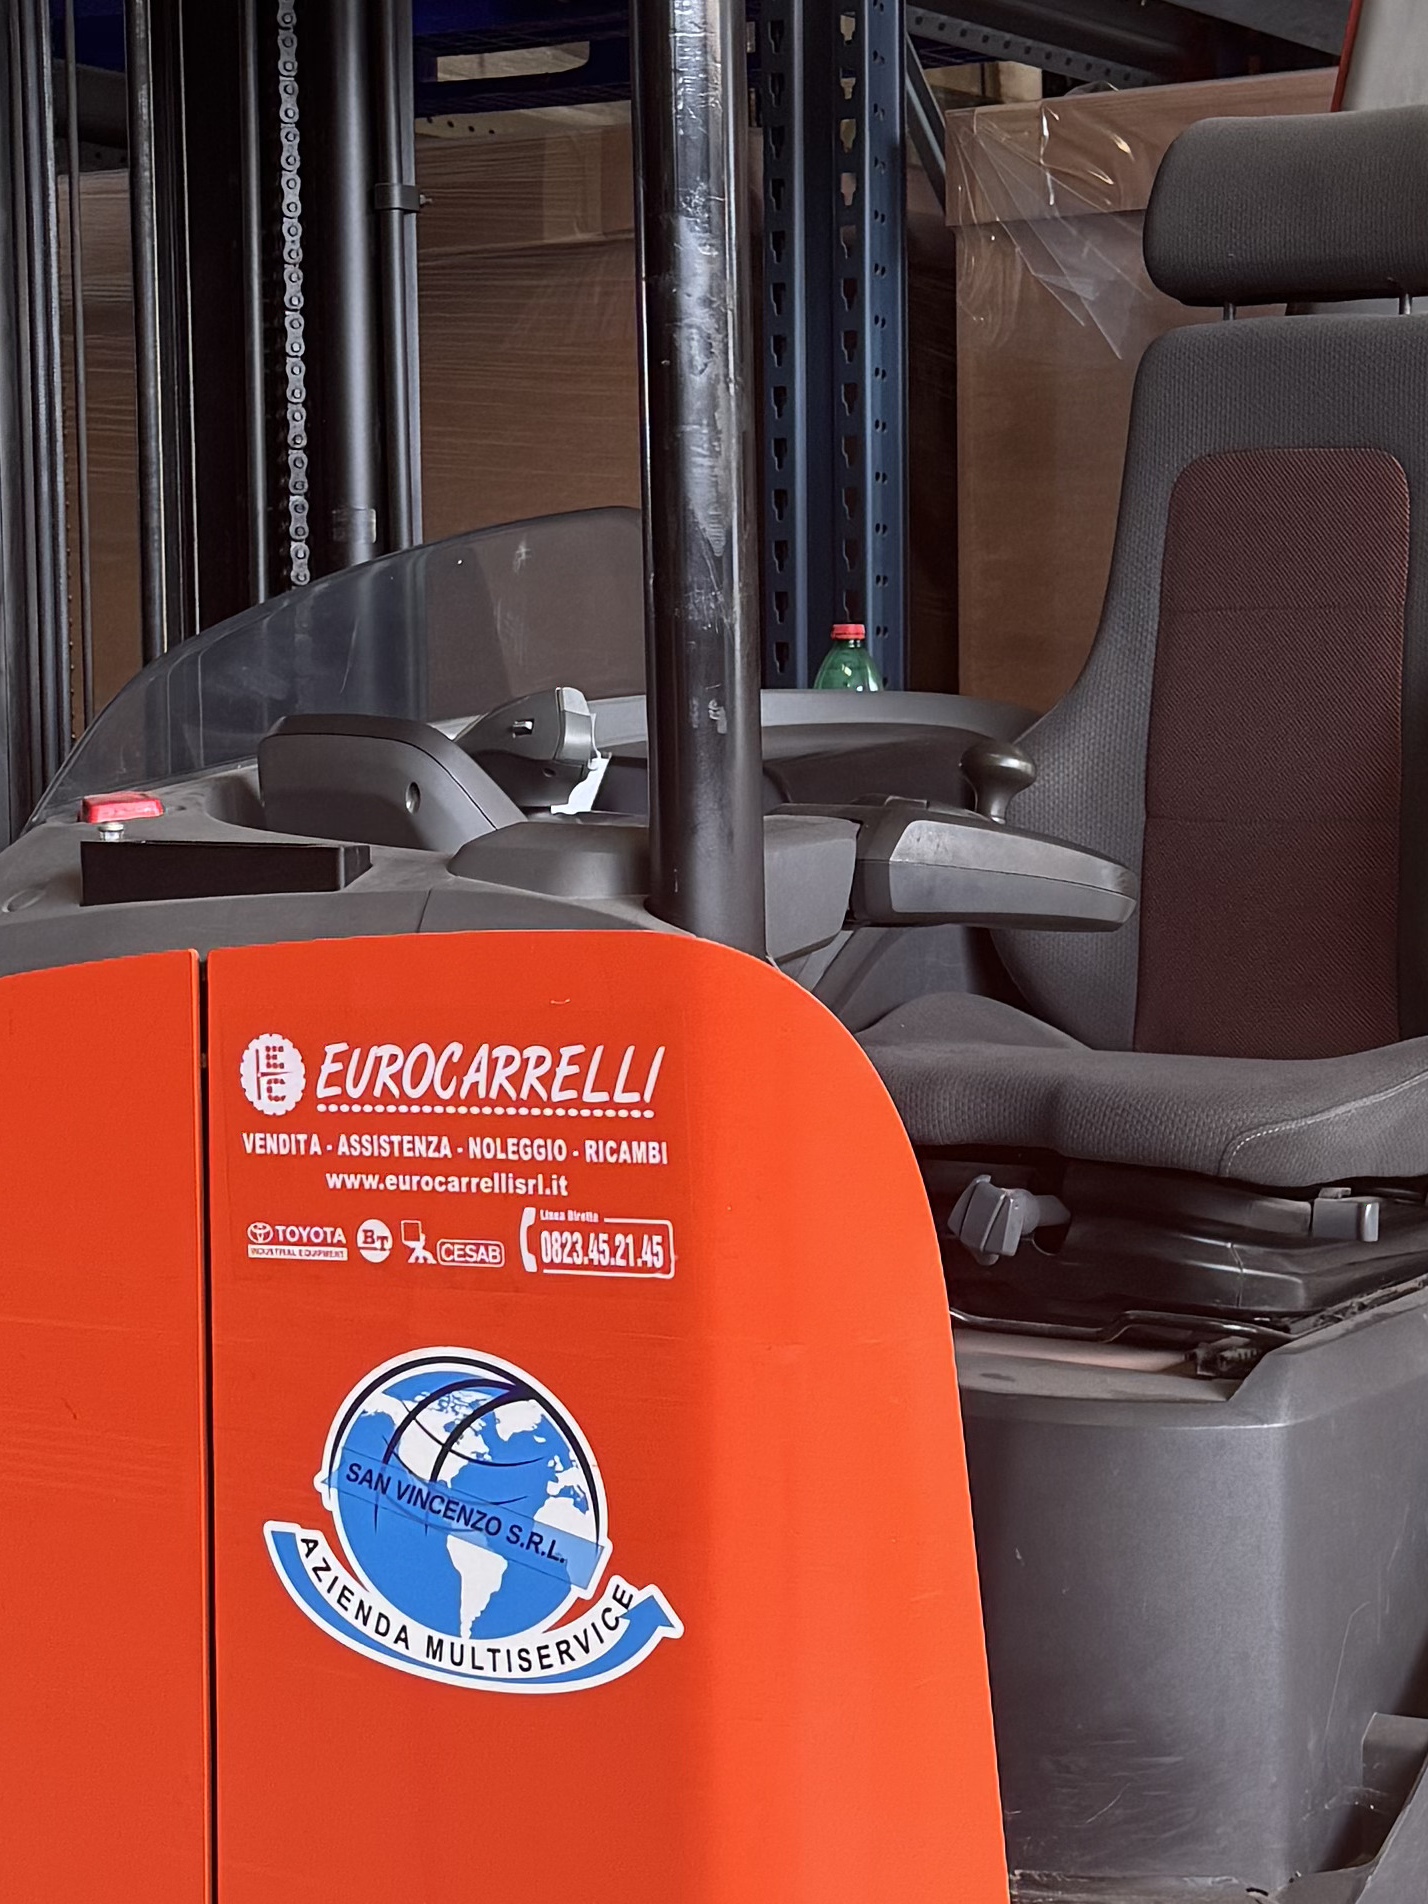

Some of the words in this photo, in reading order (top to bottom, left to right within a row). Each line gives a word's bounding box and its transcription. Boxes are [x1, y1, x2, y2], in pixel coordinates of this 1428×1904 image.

[316, 1042, 665, 1103] EUROCARRELLI
[242, 1133, 321, 1156] VENDITA
[338, 1135, 452, 1159] ASSISTENZA
[469, 1137, 567, 1162] NOLEGGIO
[585, 1140, 668, 1165] RICAMBI
[326, 1172, 568, 1196] www.eurocarrellisrl.it
[275, 1225, 347, 1245] TOYOTA
[540, 1230, 664, 1268] 0823.45.21.45
[440, 1243, 502, 1264] CESAB
[345, 1462, 392, 1496] SAN
[395, 1482, 504, 1537] VINCENZO
[505, 1524, 567, 1564] S.R.L.
[301, 1537, 411, 1651] AZIENDA
[426, 1584, 634, 1673] MULTISERVICE
